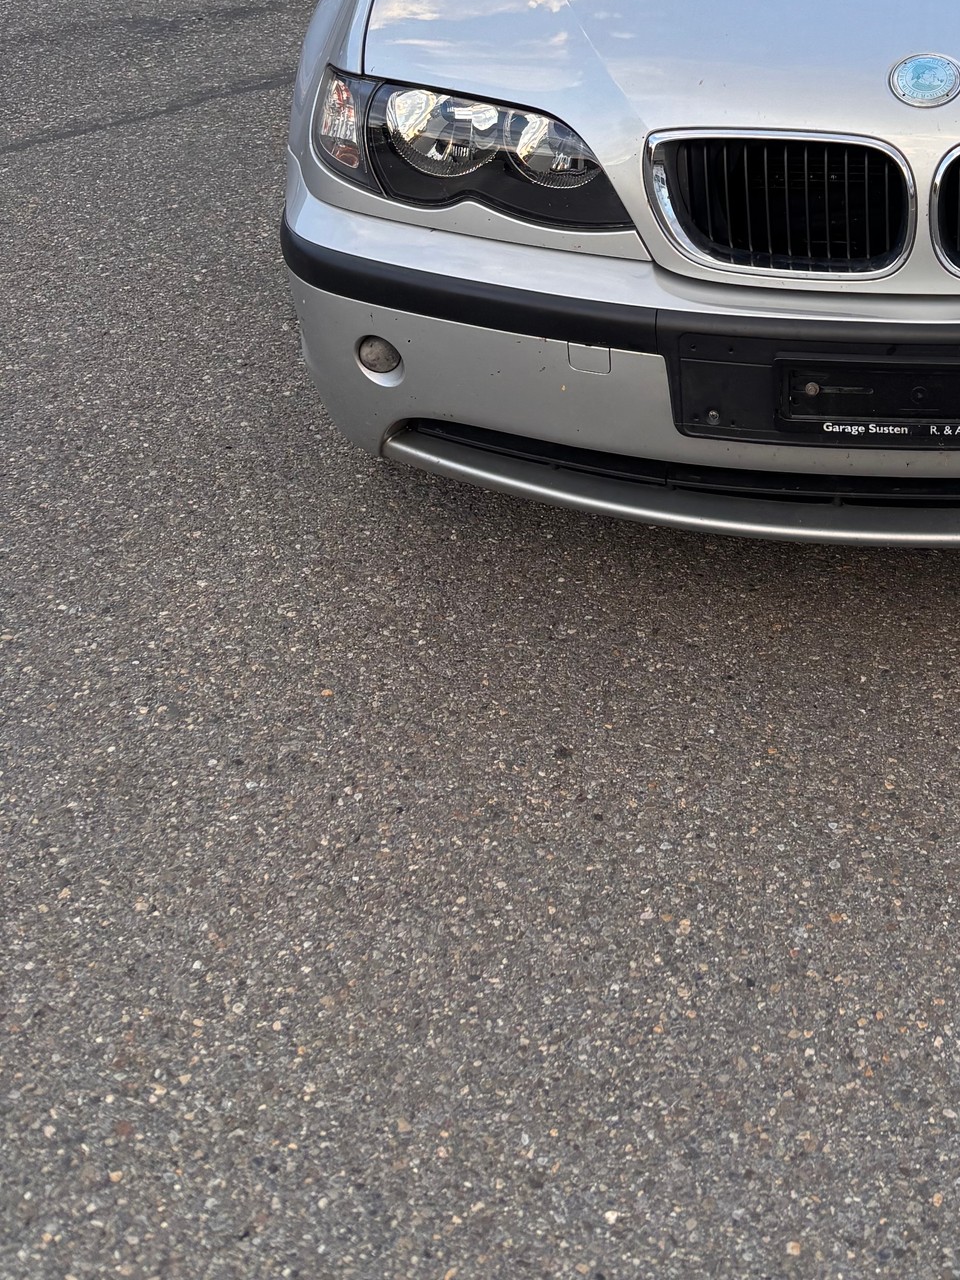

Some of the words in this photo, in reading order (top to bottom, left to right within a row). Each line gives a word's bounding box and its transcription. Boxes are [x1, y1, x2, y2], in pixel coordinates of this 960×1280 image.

[823, 422, 866, 436] Garage
[868, 423, 909, 435] Susten
[930, 425, 941, 435] R.
[943, 425, 953, 435] &
